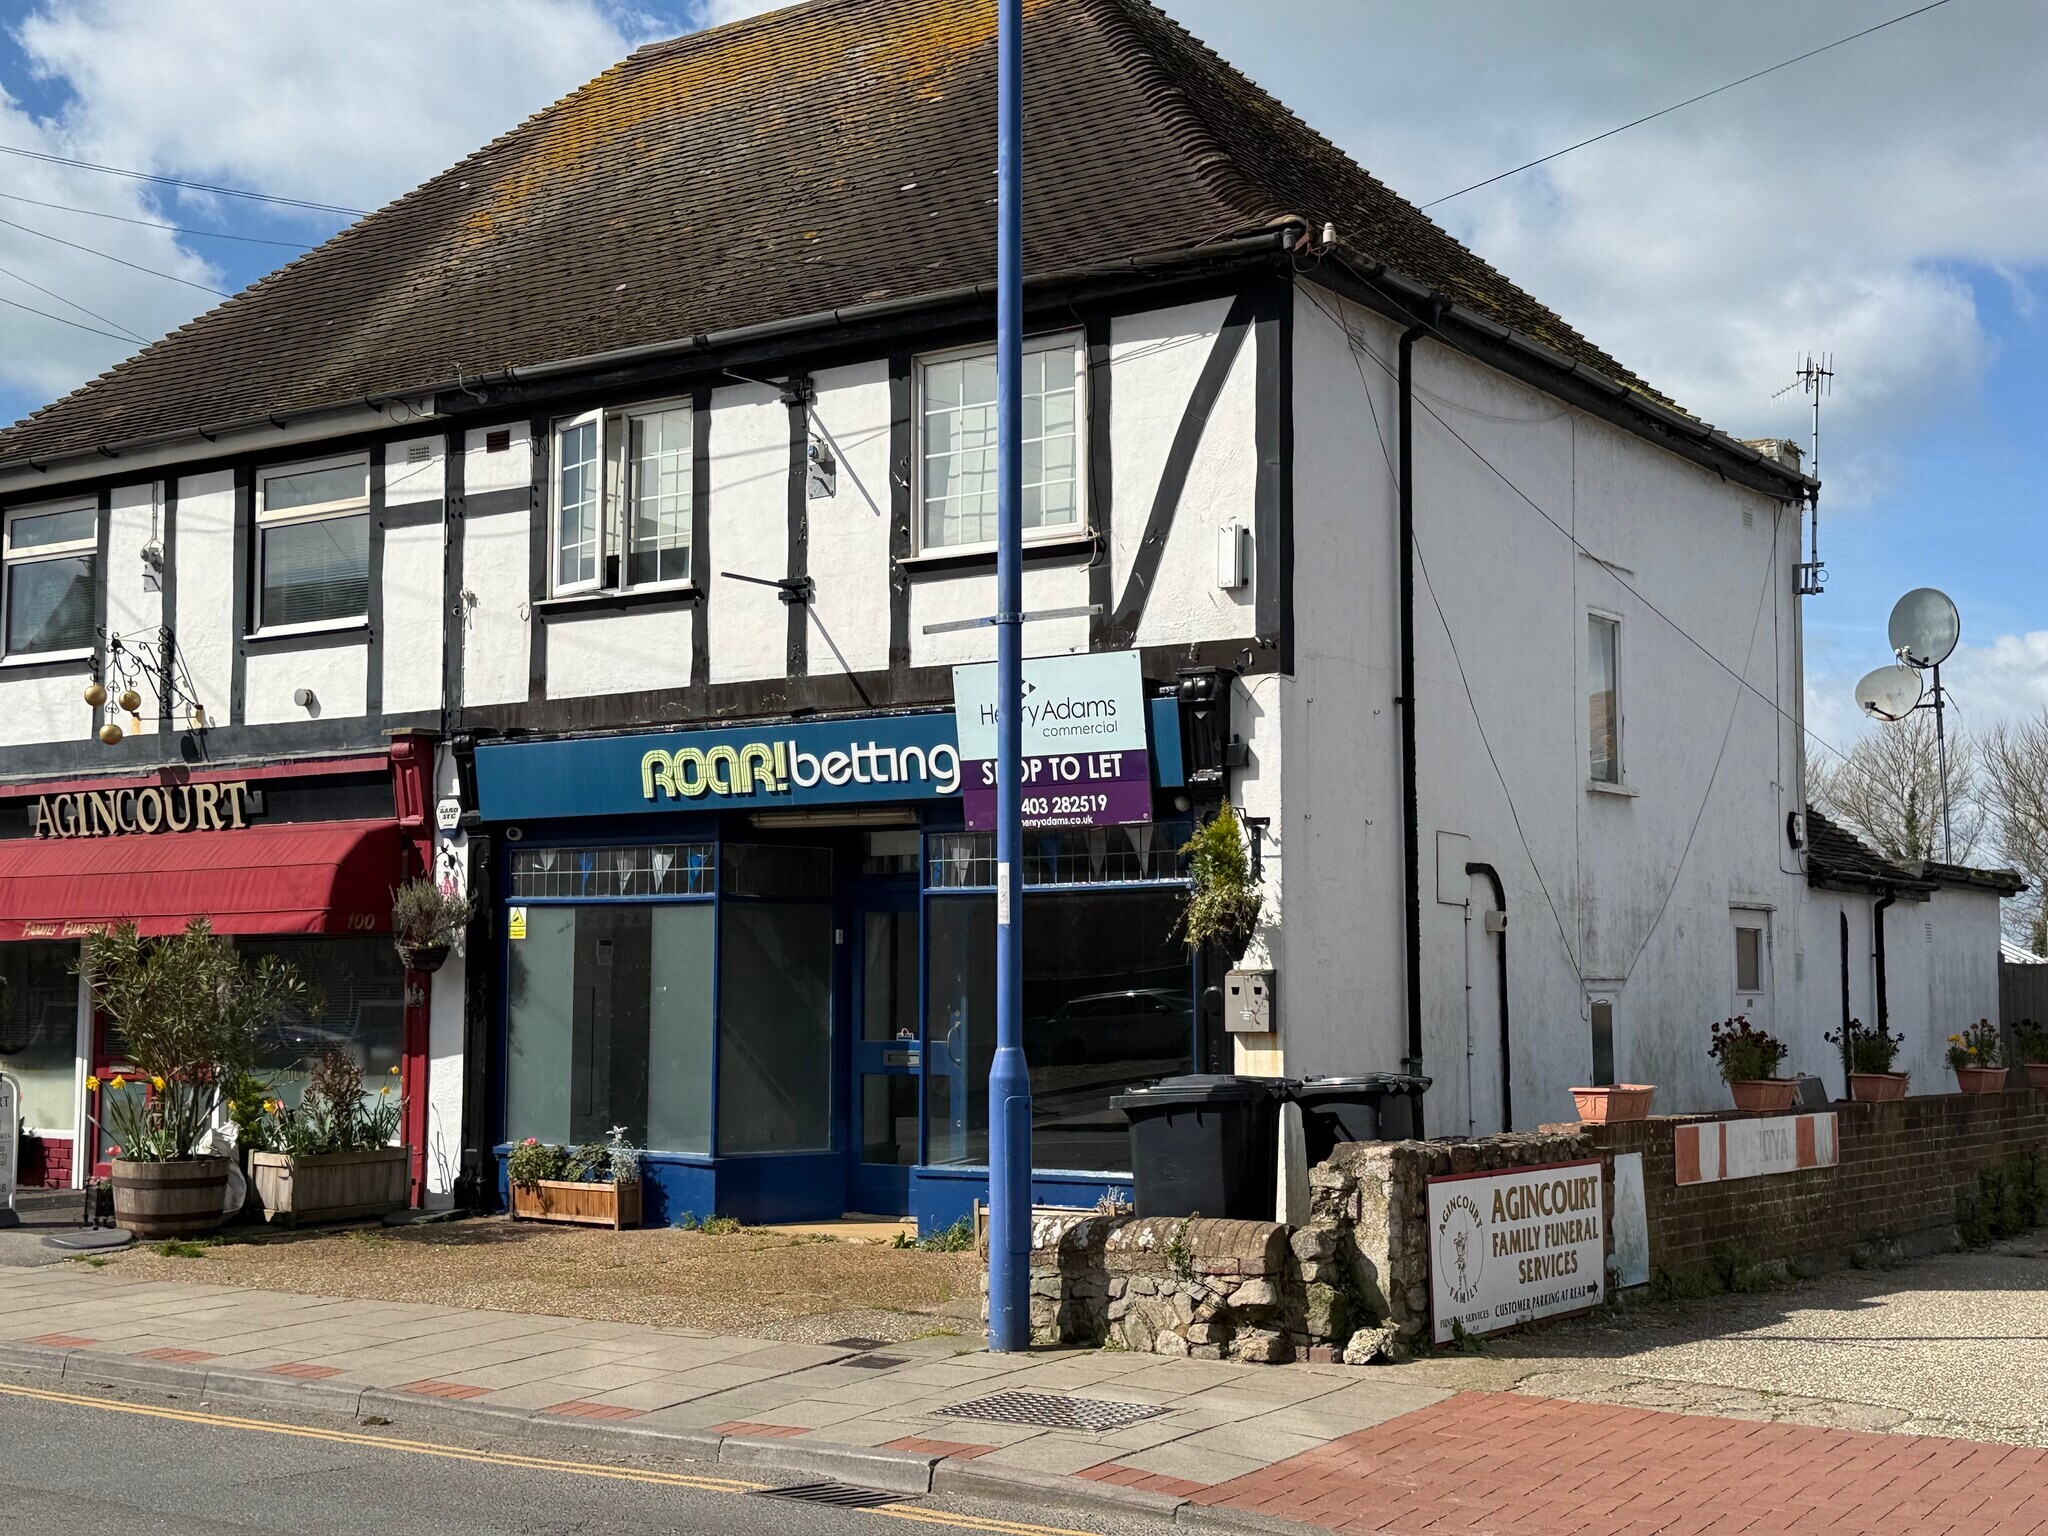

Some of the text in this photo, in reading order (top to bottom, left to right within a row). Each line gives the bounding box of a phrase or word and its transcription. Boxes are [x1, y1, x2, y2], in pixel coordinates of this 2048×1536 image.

[980, 697, 1117, 728] Hry Adams
[1042, 720, 1118, 738] commercial
[982, 753, 1122, 785] SP TO LET
[34, 780, 248, 838] AGINCOURT
[1052, 794, 1108, 813] 282519
[347, 912, 376, 930] 100
[1439, 1195, 1483, 1236] AGINCOURT
[1491, 1176, 1598, 1224] AGINCOURT
[1492, 1216, 1599, 1258] FAMILY FUNERAL
[1519, 1249, 1578, 1284] SERVICES
[1450, 1281, 1478, 1304] FAMILY
[1495, 1285, 1586, 1317] CUSTOMER PARKING AT REAR
[1465, 1309, 1490, 1323] SERVICES
